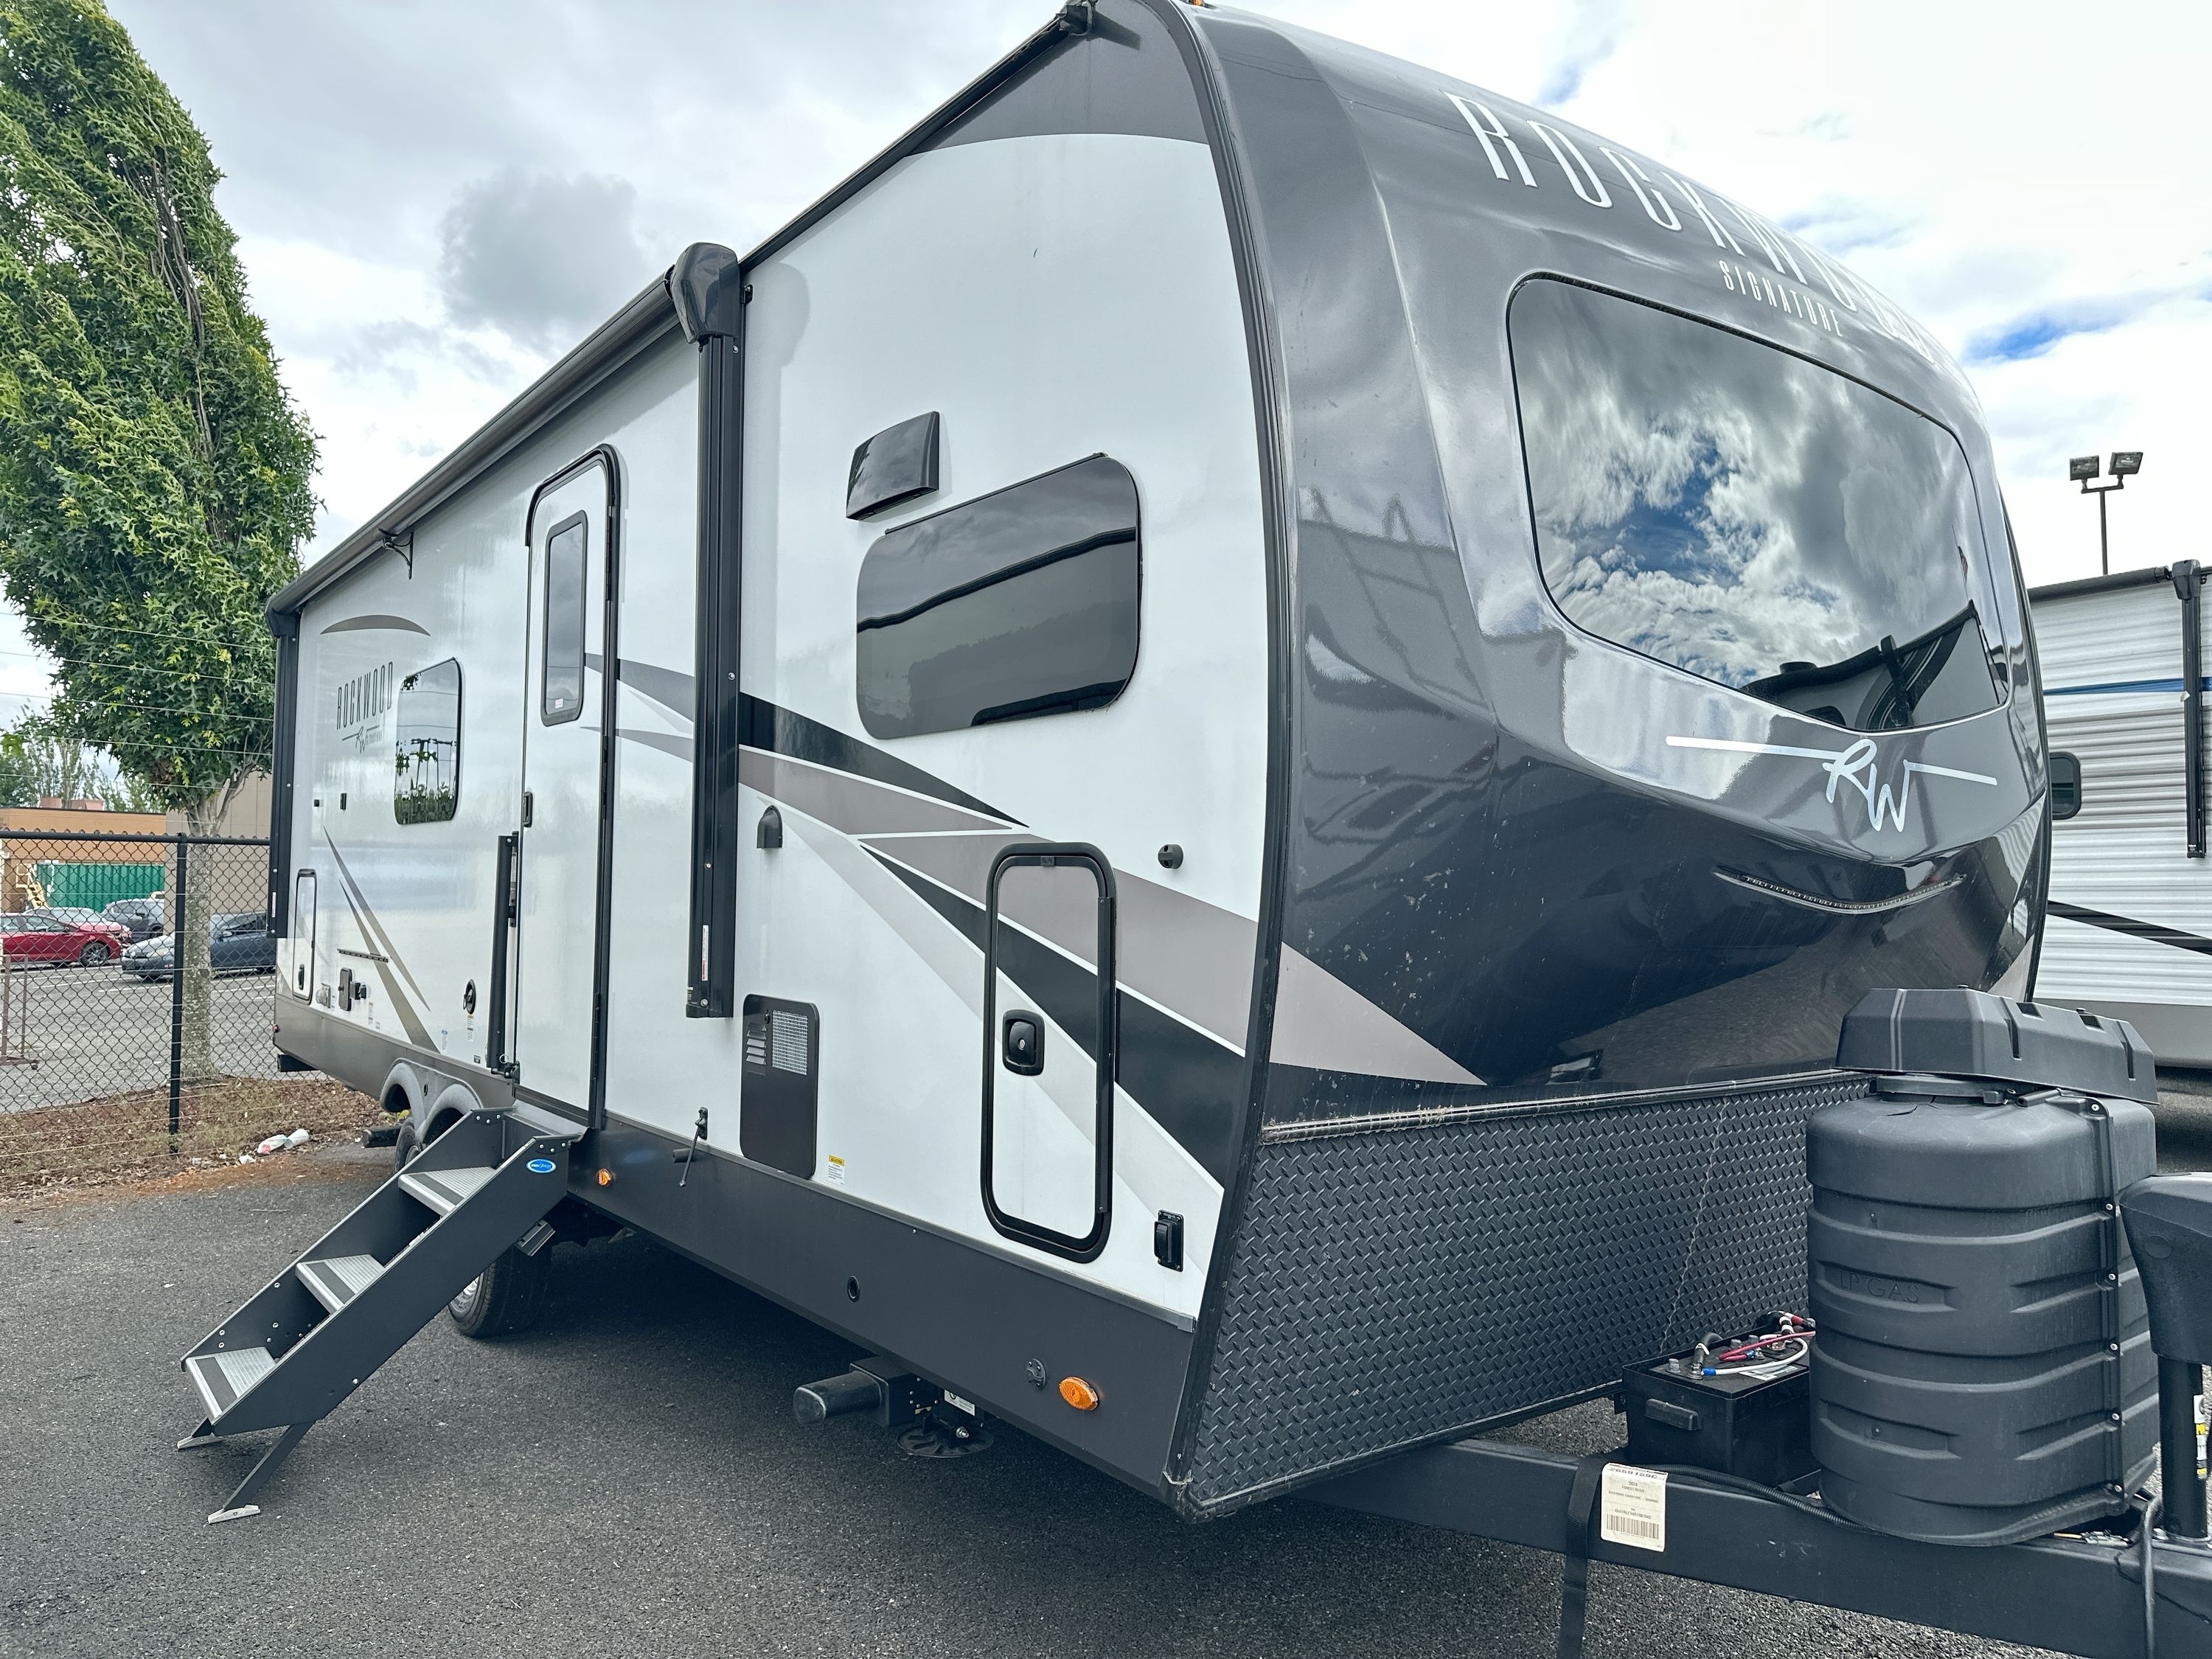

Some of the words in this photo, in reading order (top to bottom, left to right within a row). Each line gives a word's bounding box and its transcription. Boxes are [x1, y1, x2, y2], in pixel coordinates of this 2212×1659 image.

[1443, 91, 1935, 364] ROCKWOOD
[1719, 260, 1843, 338] SIGNATURE
[336, 661, 393, 730] ROCKWOOD
[1822, 738, 1911, 832] RW
[1840, 1270, 1860, 1290] LP
[1866, 1277, 1919, 1303] GAS
